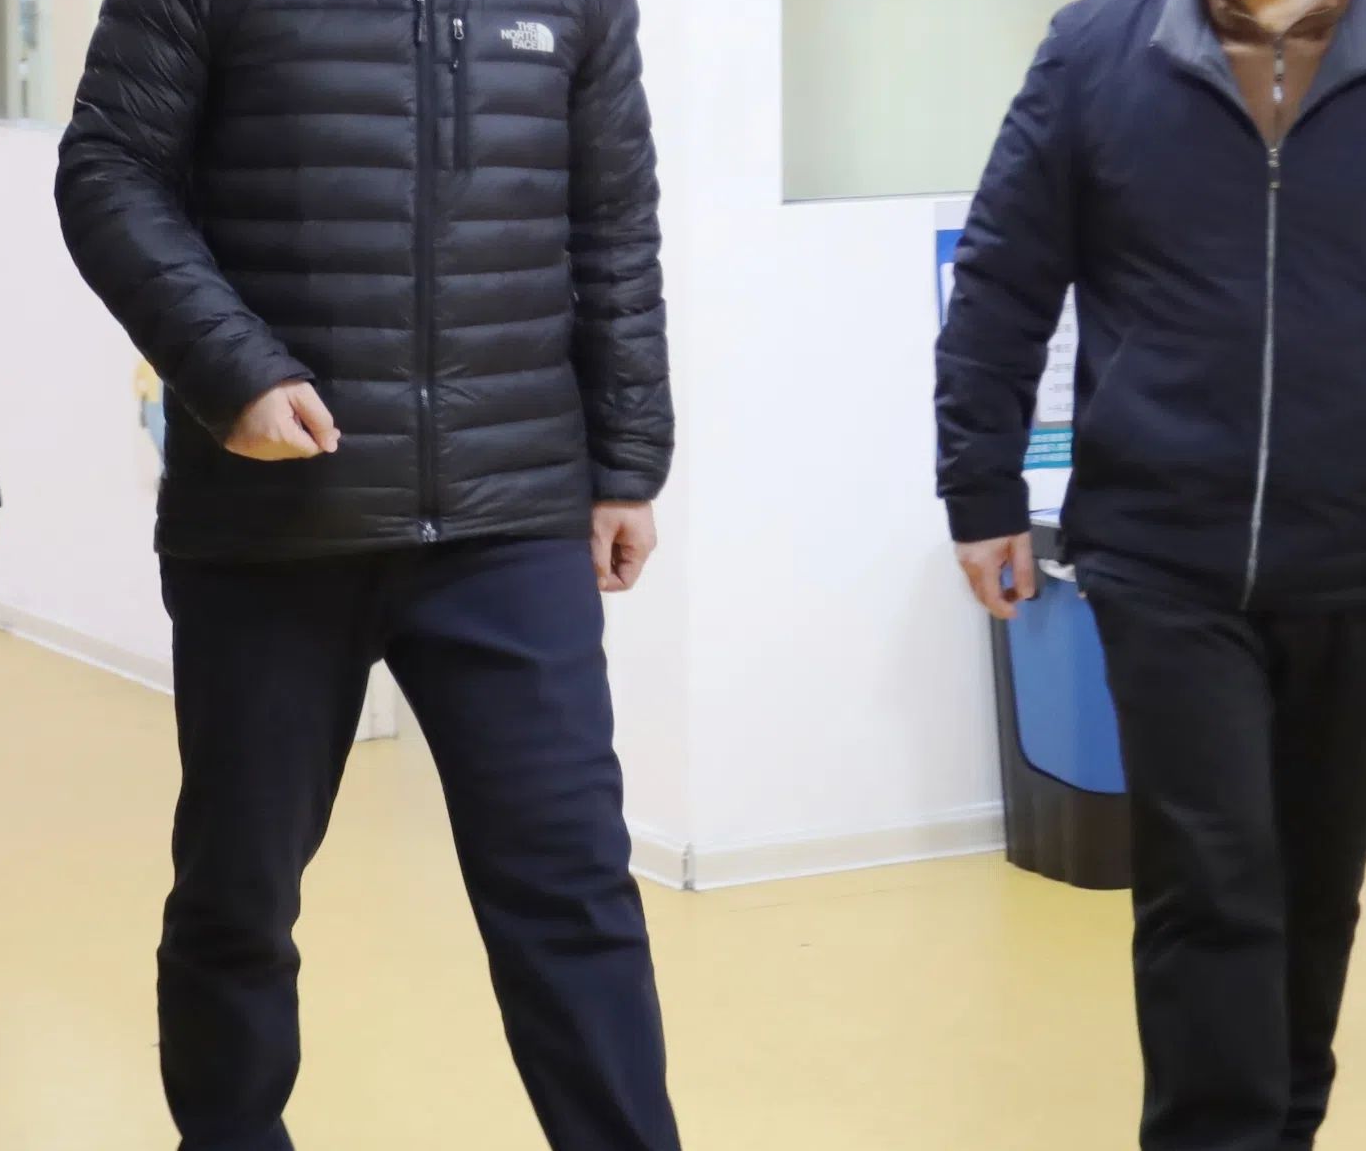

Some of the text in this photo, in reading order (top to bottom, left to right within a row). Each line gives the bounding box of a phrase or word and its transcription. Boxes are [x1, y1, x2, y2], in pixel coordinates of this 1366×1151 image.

[515, 20, 537, 30] THE
[500, 29, 538, 40] NORTH
[512, 39, 538, 50] FACE
